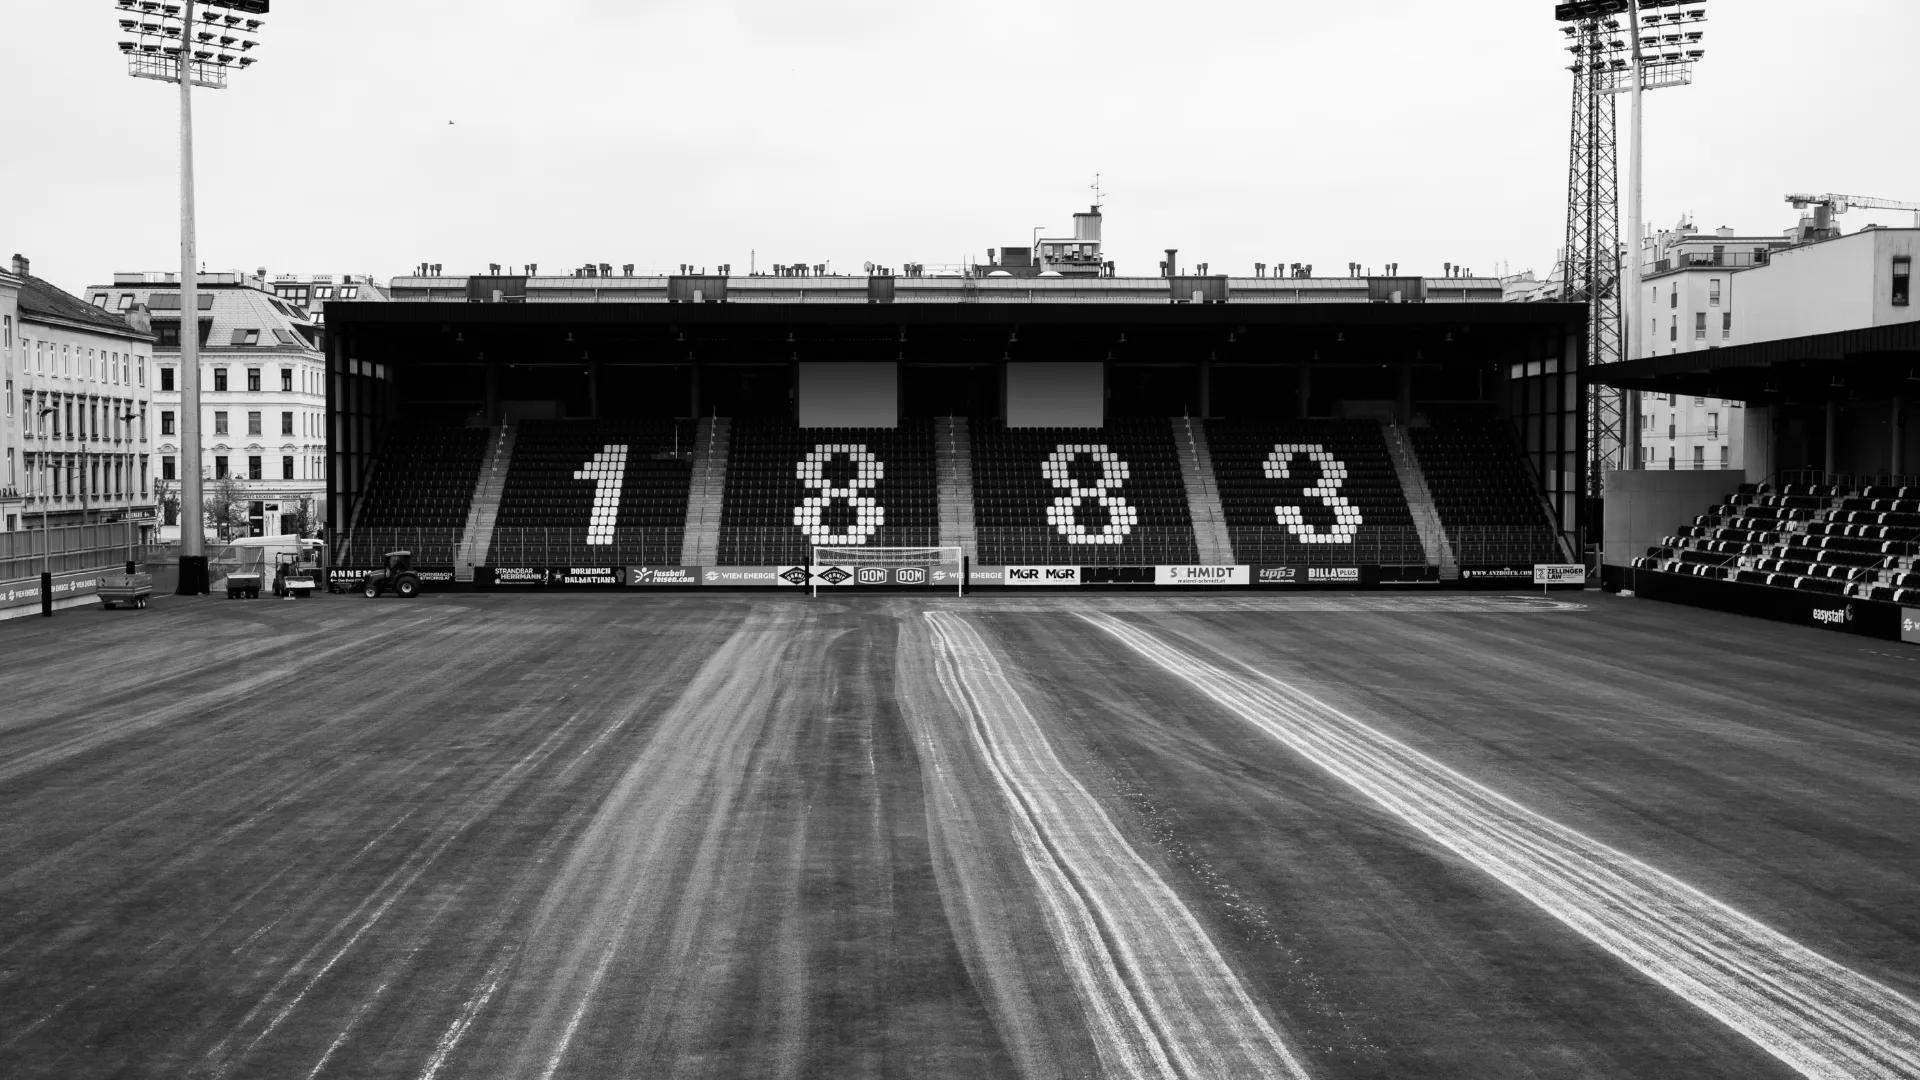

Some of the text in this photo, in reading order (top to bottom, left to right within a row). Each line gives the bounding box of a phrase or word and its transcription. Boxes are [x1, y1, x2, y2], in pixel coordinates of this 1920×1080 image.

[861, 570, 884, 581] DOM
[899, 570, 922, 581] DOM
[1009, 568, 1039, 579] MGR
[1046, 568, 1075, 579] MGR
[1259, 567, 1296, 579] tipp3
[1308, 568, 1337, 577] BILLA
[76, 581, 85, 589] WIEN
[564, 576, 616, 584] DALMATIANS
[16, 590, 25, 598] WIEN
[25, 588, 39, 597] ENERGIE
[1812, 608, 1844, 624] easystaff
